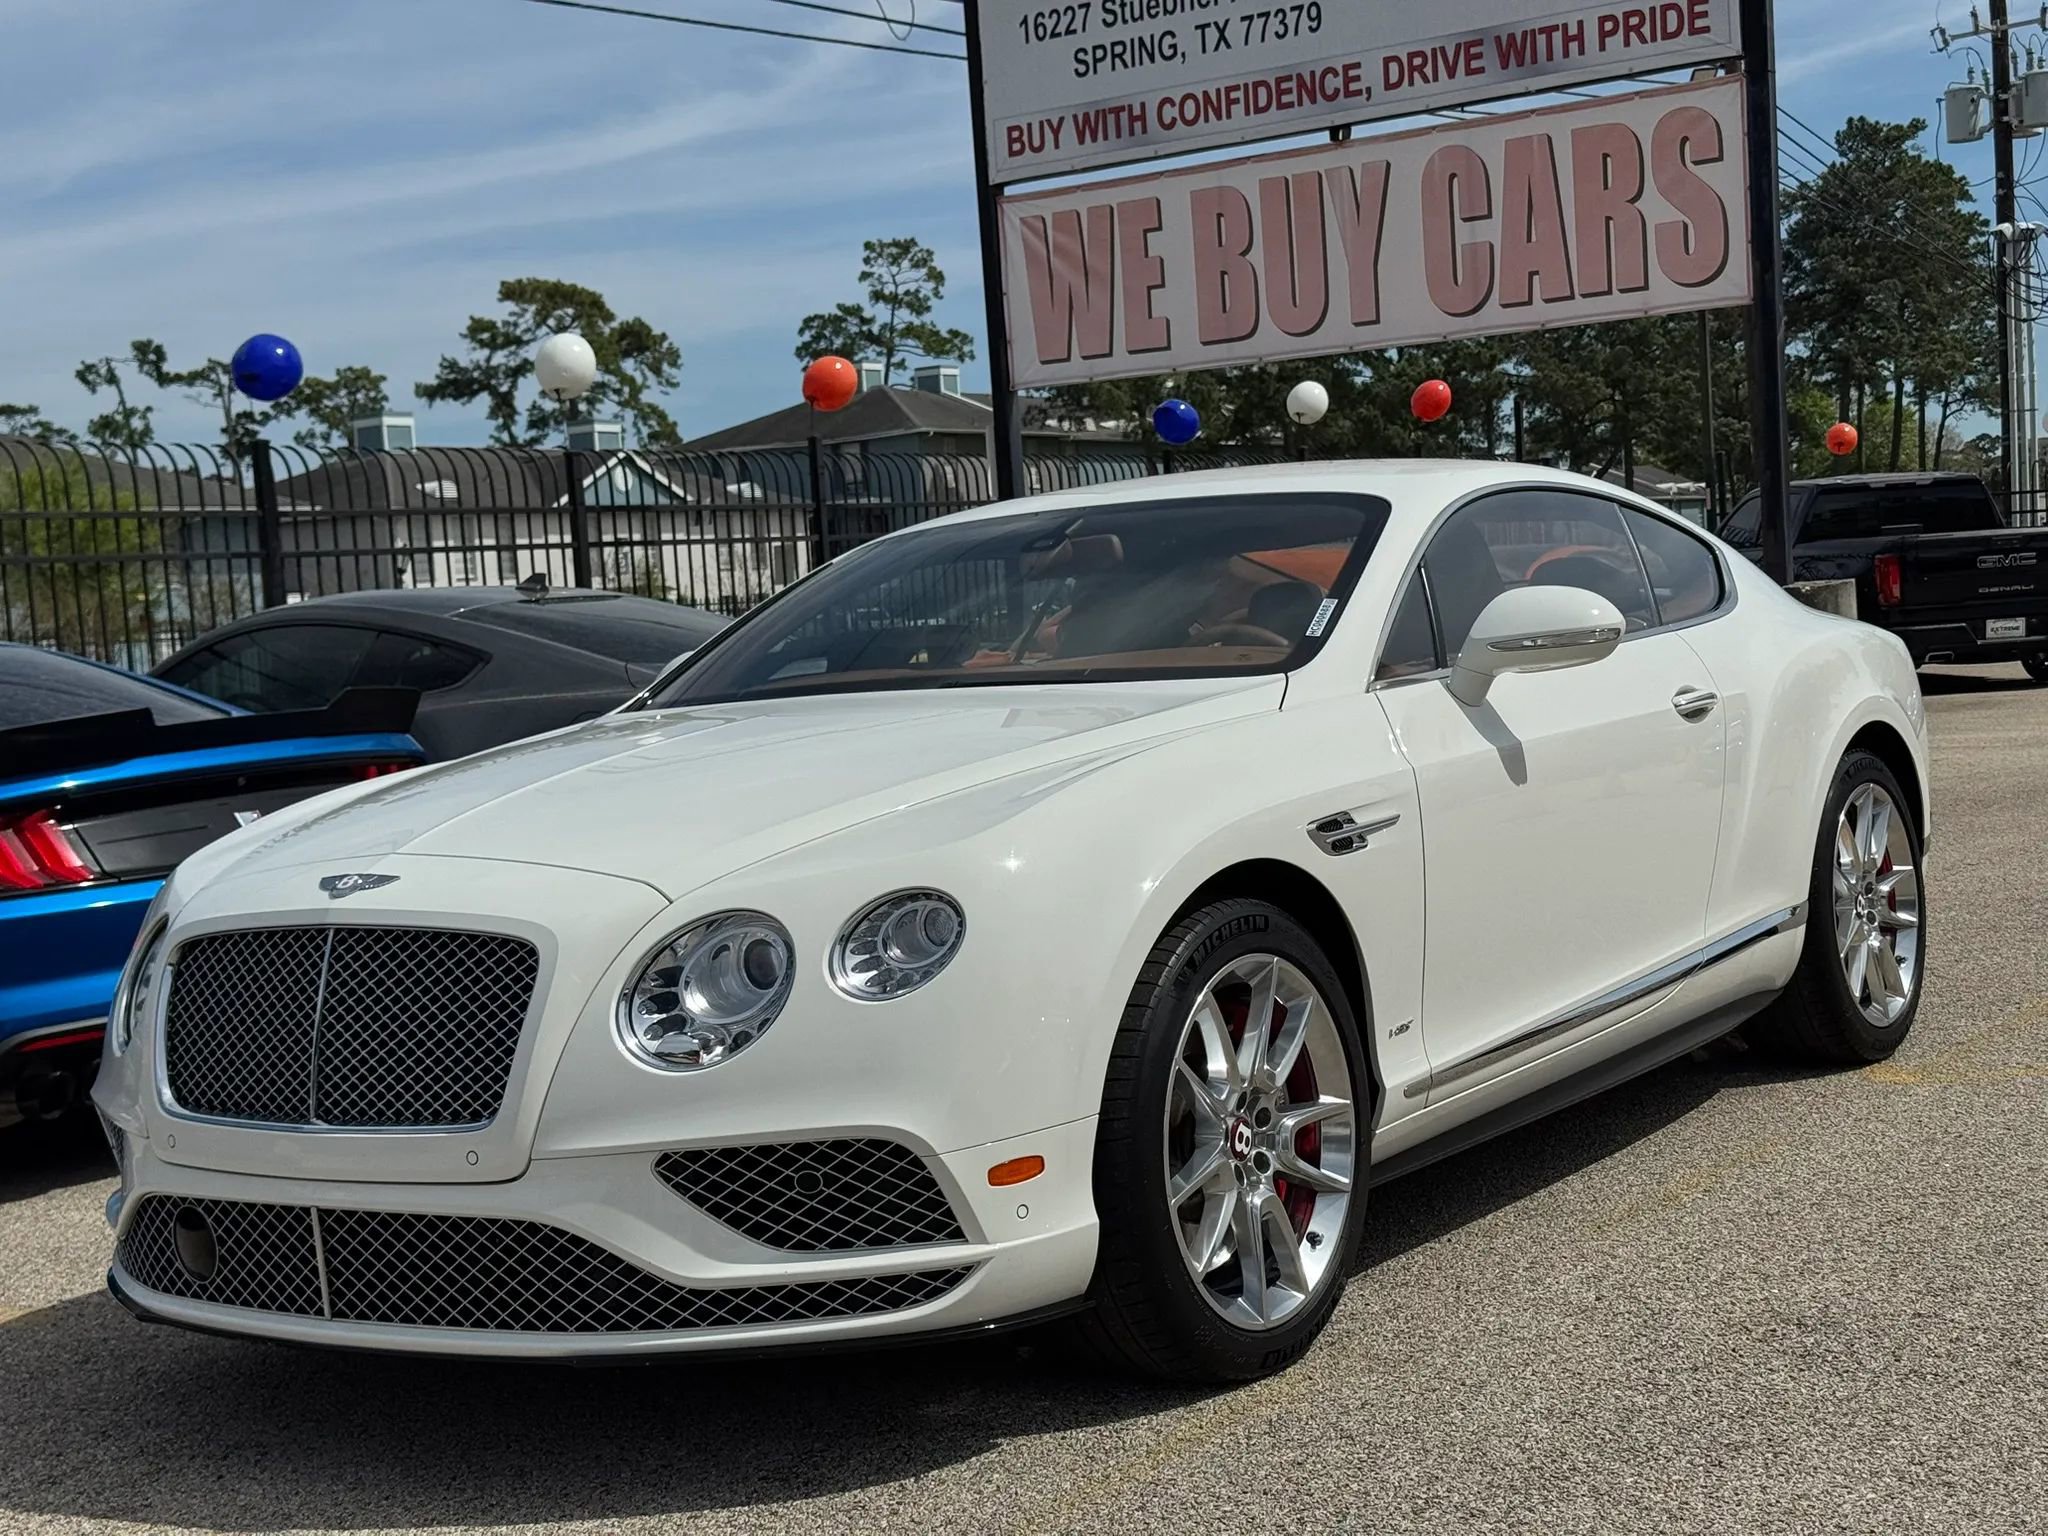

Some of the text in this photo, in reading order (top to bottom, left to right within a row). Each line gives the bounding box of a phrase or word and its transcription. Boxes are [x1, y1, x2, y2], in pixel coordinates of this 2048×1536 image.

[1019, 2, 1091, 44] 16227
[1073, 1, 1322, 78] SPRING, TX 77379
[1006, 0, 1711, 158] BUY WITH CONFIDENCE, DRIVE WITH PRIDE
[1019, 105, 1729, 365] WE BUY CARS
[1977, 552, 2037, 568] GMC
[1192, 915, 1266, 967] MICHELIN
